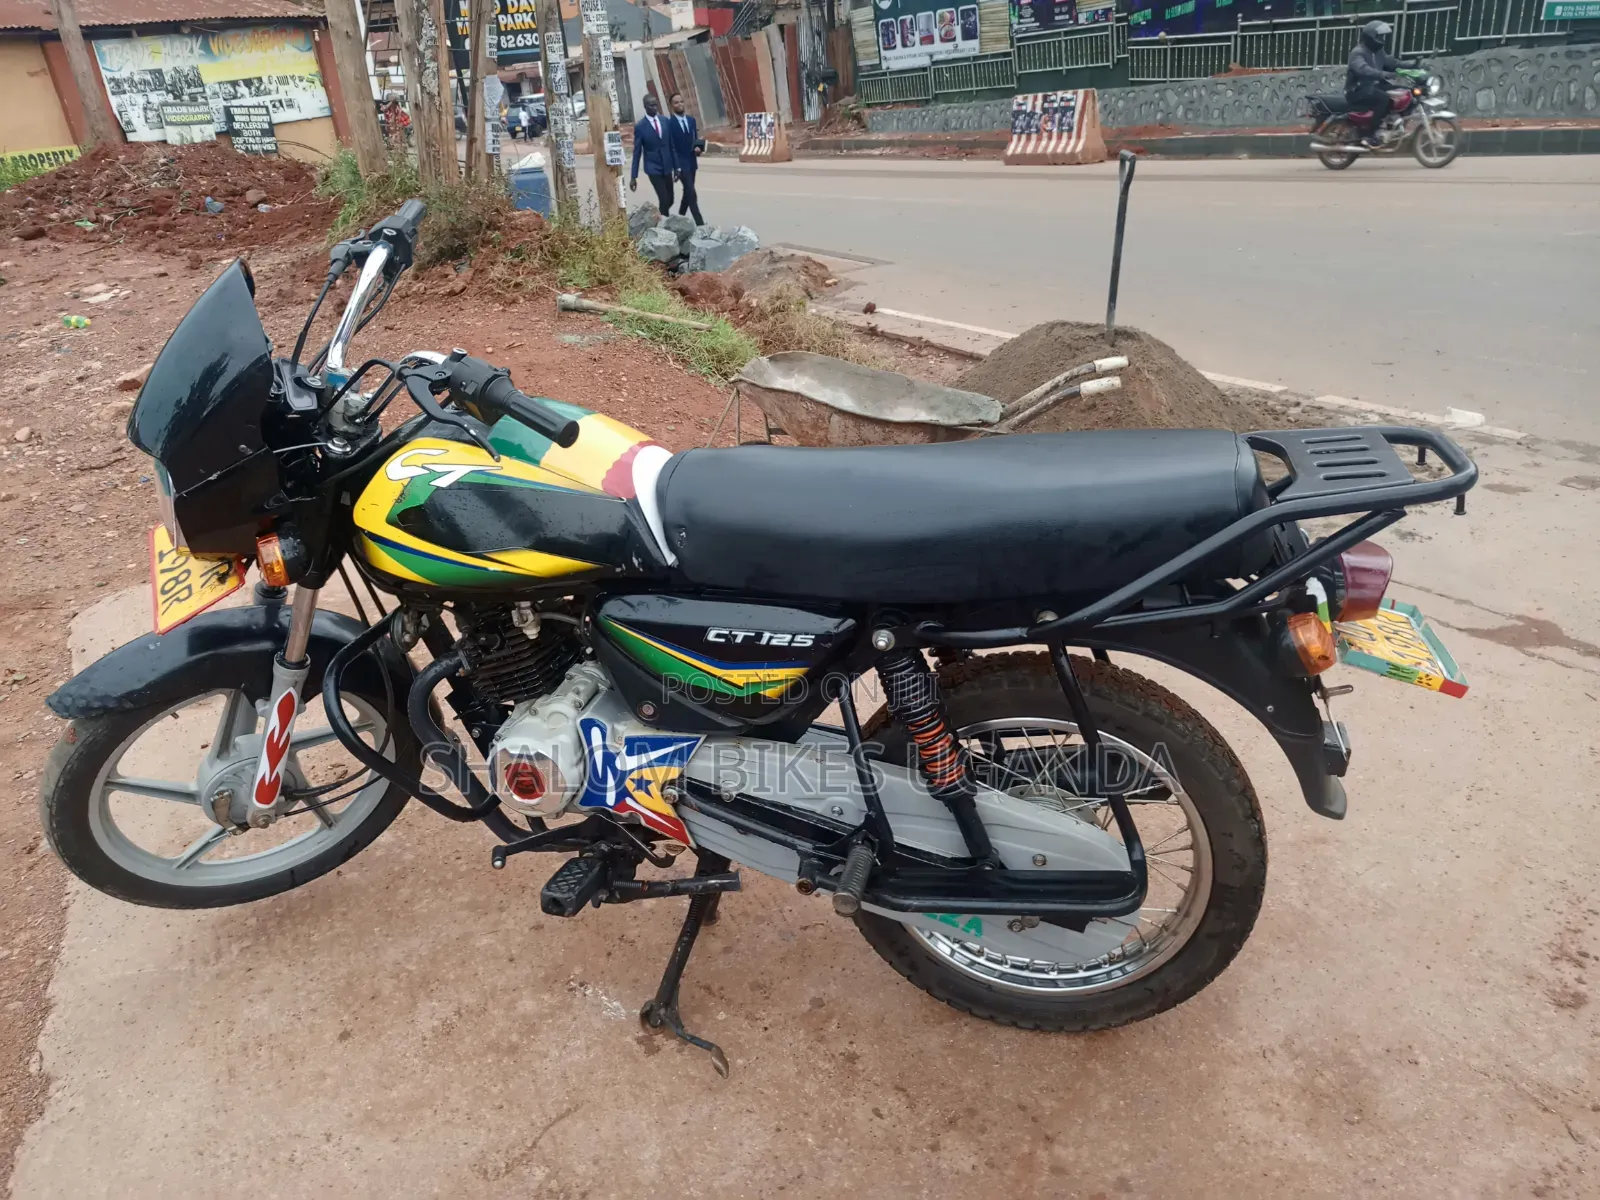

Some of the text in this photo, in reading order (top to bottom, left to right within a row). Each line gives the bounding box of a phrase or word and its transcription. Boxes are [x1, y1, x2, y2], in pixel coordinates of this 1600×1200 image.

[498, 12, 537, 31] PARK
[162, 105, 210, 114] TRADE MARK
[166, 113, 211, 122] VIDEOGRAPHY
[242, 129, 261, 137] BOTH
[11, 150, 74, 170] PROPERTY
[705, 626, 816, 648] CT 125
